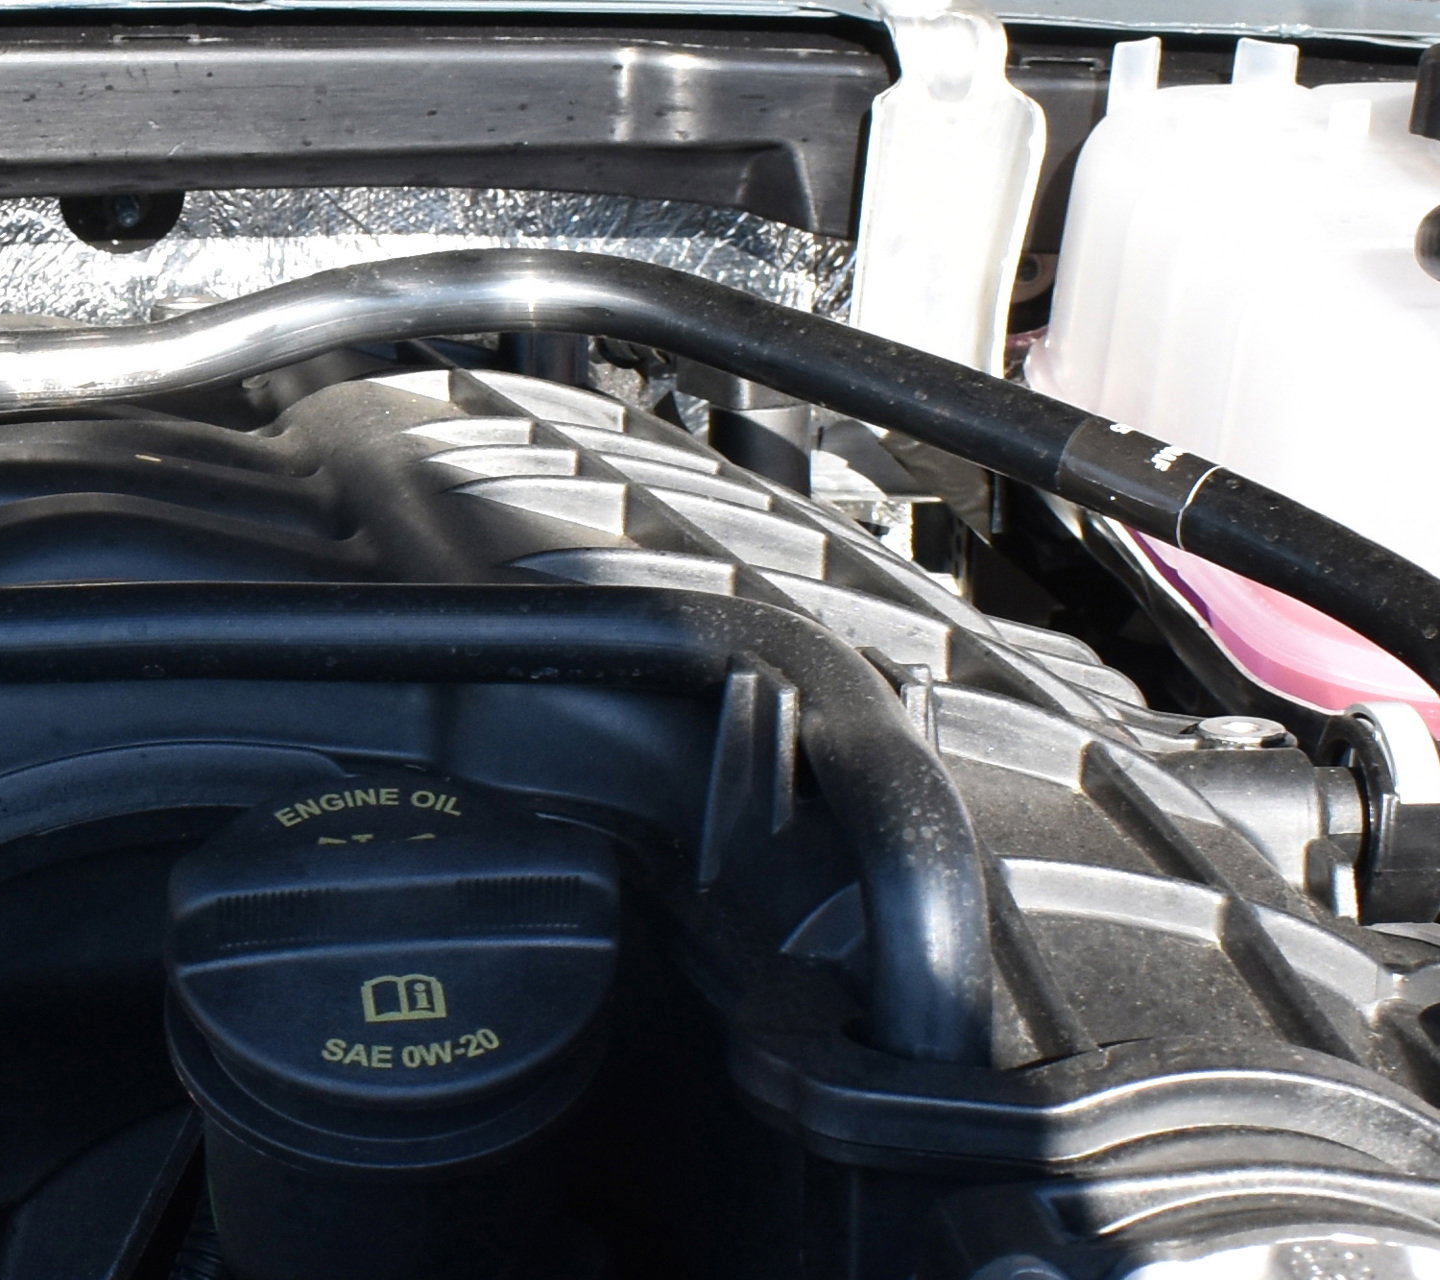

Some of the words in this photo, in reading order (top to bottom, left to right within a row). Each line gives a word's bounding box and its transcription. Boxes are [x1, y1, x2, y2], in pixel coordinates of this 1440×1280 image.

[274, 788, 400, 828] ENGINE
[410, 790, 463, 817] OIL
[321, 1038, 393, 1069] SAE
[402, 1028, 501, 1069] 0W-20
